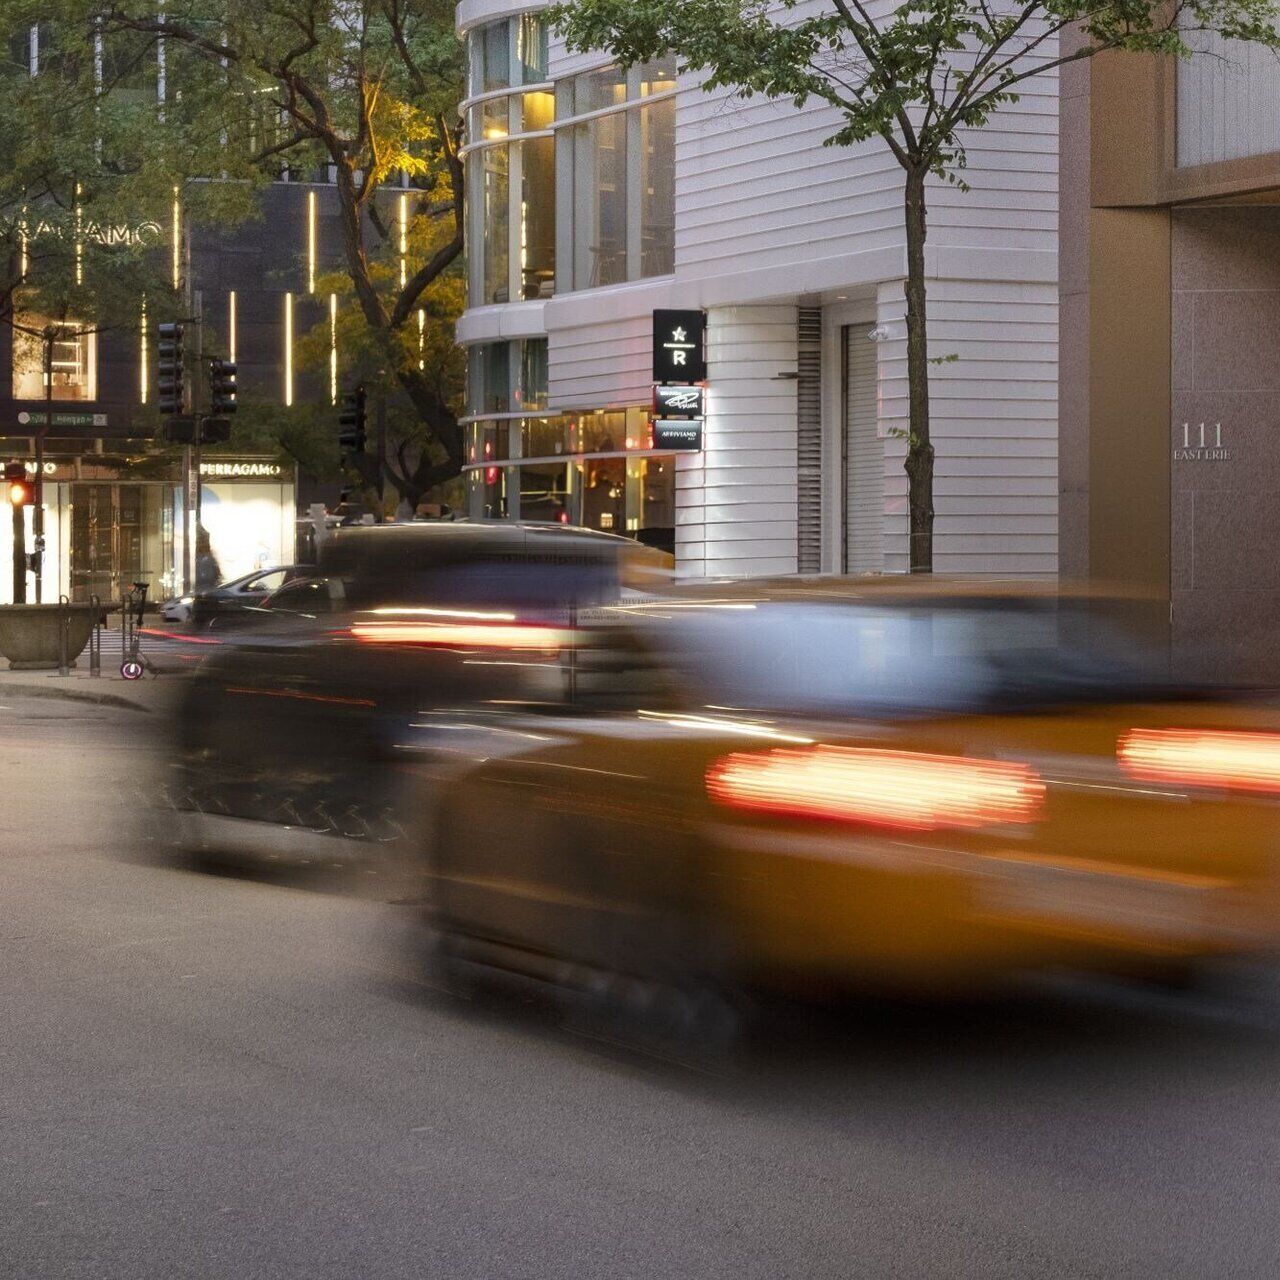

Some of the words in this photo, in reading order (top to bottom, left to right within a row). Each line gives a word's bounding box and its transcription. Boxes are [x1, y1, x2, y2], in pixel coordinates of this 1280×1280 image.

[673, 350, 686, 365] R
[1181, 422, 1221, 448] 111
[1174, 450, 1202, 460] EAST
[1205, 450, 1231, 460] ERIE
[200, 463, 281, 475] FERRAGAMO
